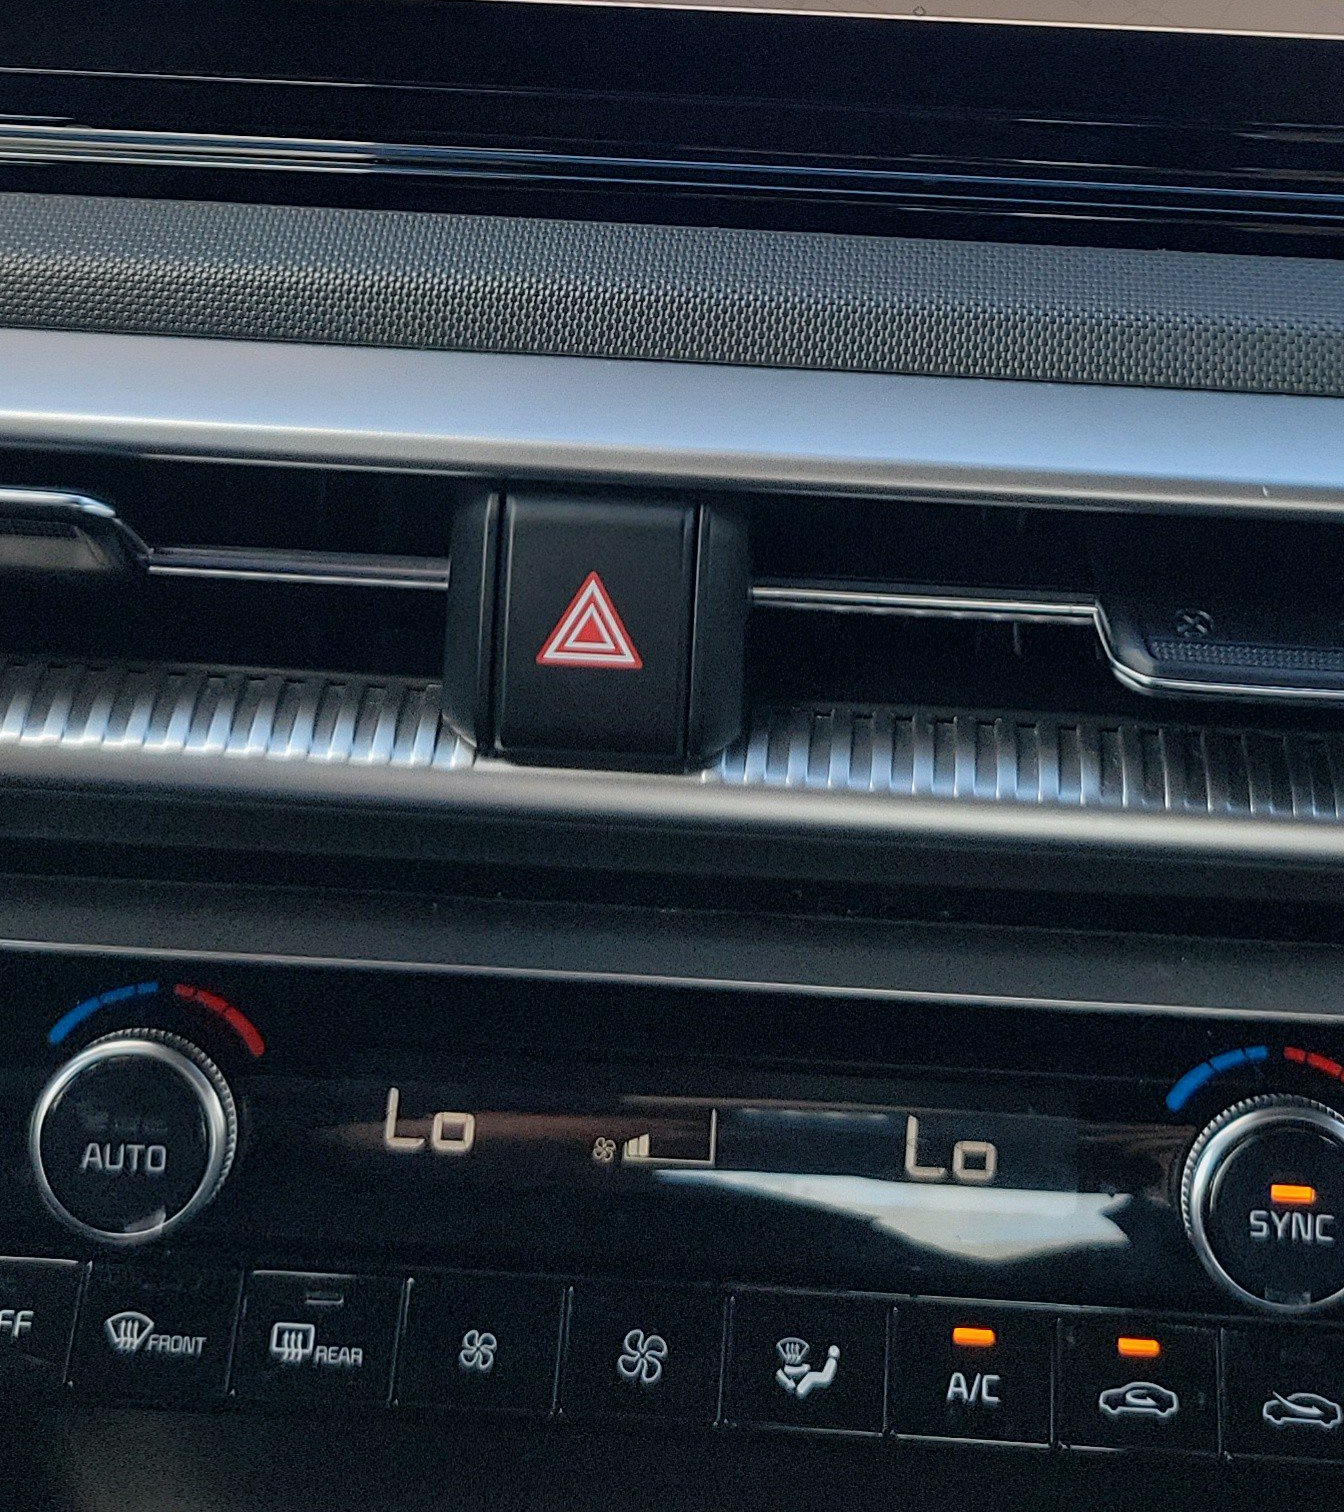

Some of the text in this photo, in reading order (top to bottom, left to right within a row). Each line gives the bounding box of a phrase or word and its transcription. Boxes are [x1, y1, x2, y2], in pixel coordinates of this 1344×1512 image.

[385, 1087, 476, 1151] Lo
[81, 1142, 168, 1170] AUTO
[905, 1114, 997, 1182] Lo
[1249, 1209, 1336, 1243] SYNC
[146, 1333, 208, 1357] FRONT
[314, 1345, 364, 1367] REAR
[946, 1371, 1002, 1404] A/C
